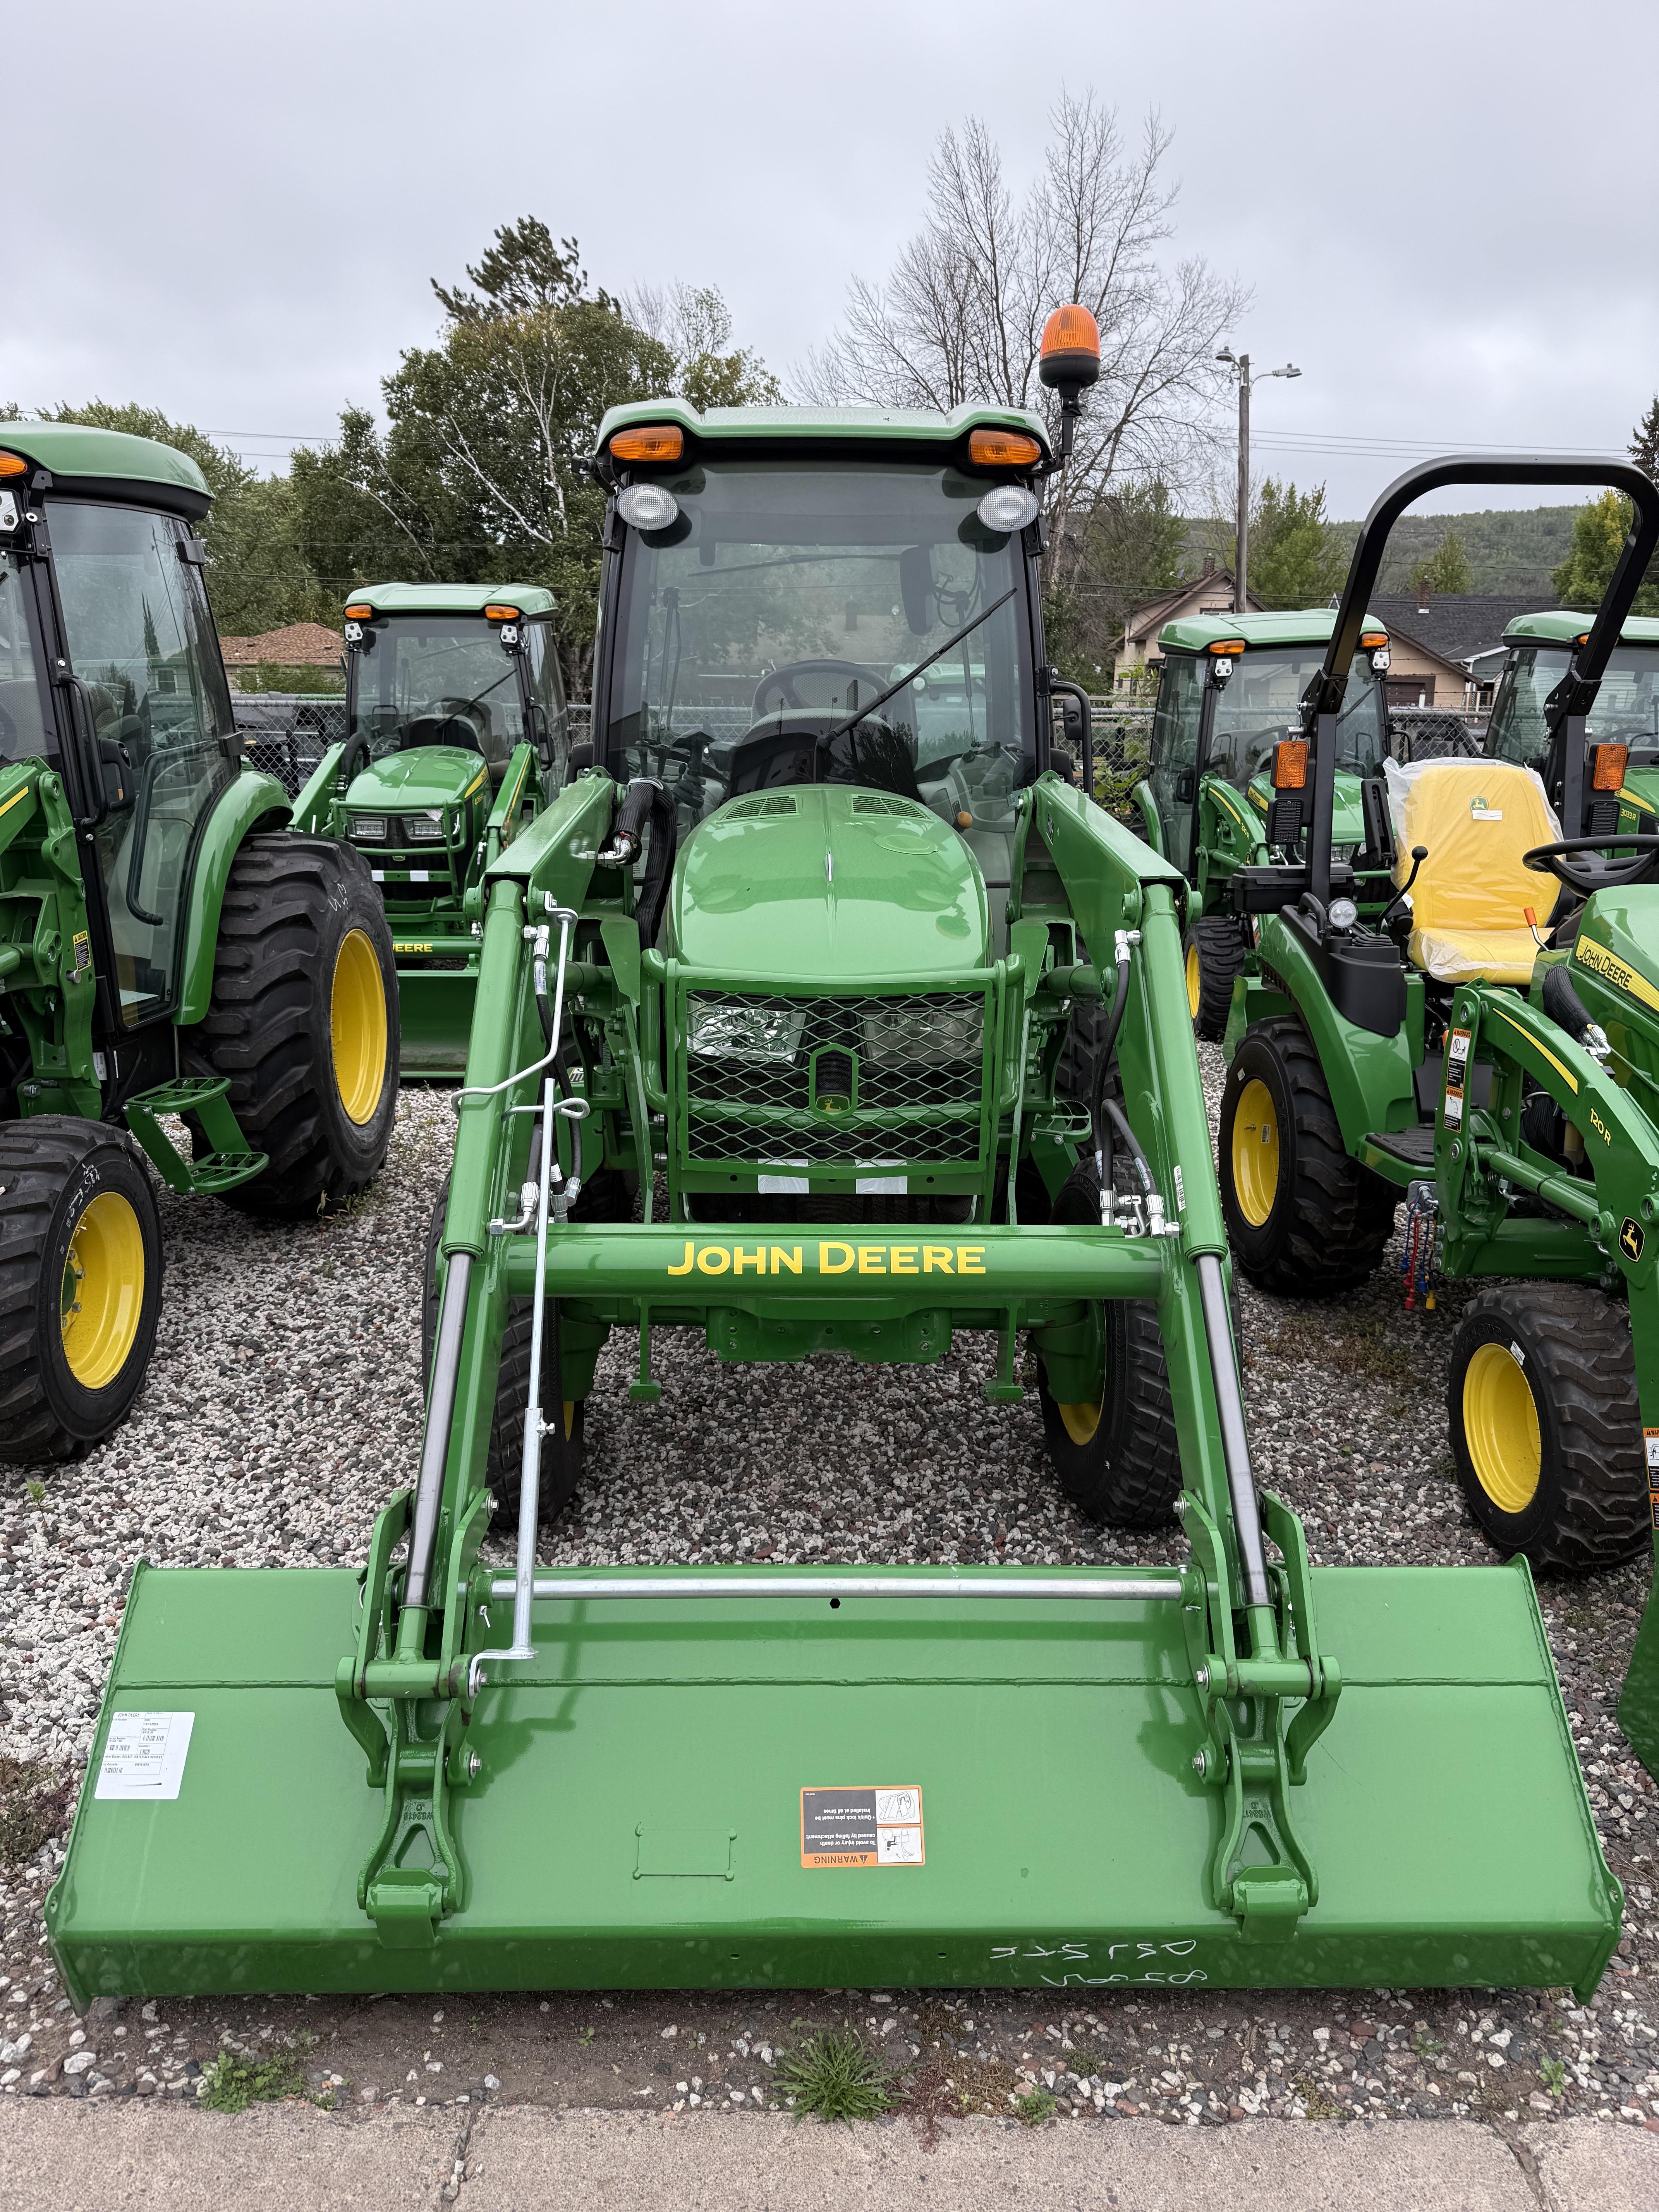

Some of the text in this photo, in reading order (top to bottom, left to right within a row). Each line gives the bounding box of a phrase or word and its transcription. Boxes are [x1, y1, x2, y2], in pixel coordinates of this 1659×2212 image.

[1579, 945, 1633, 989] JOHN DEERE
[668, 1242, 986, 1275] JOHN DEERE
[814, 1855, 858, 1864] WARNING
